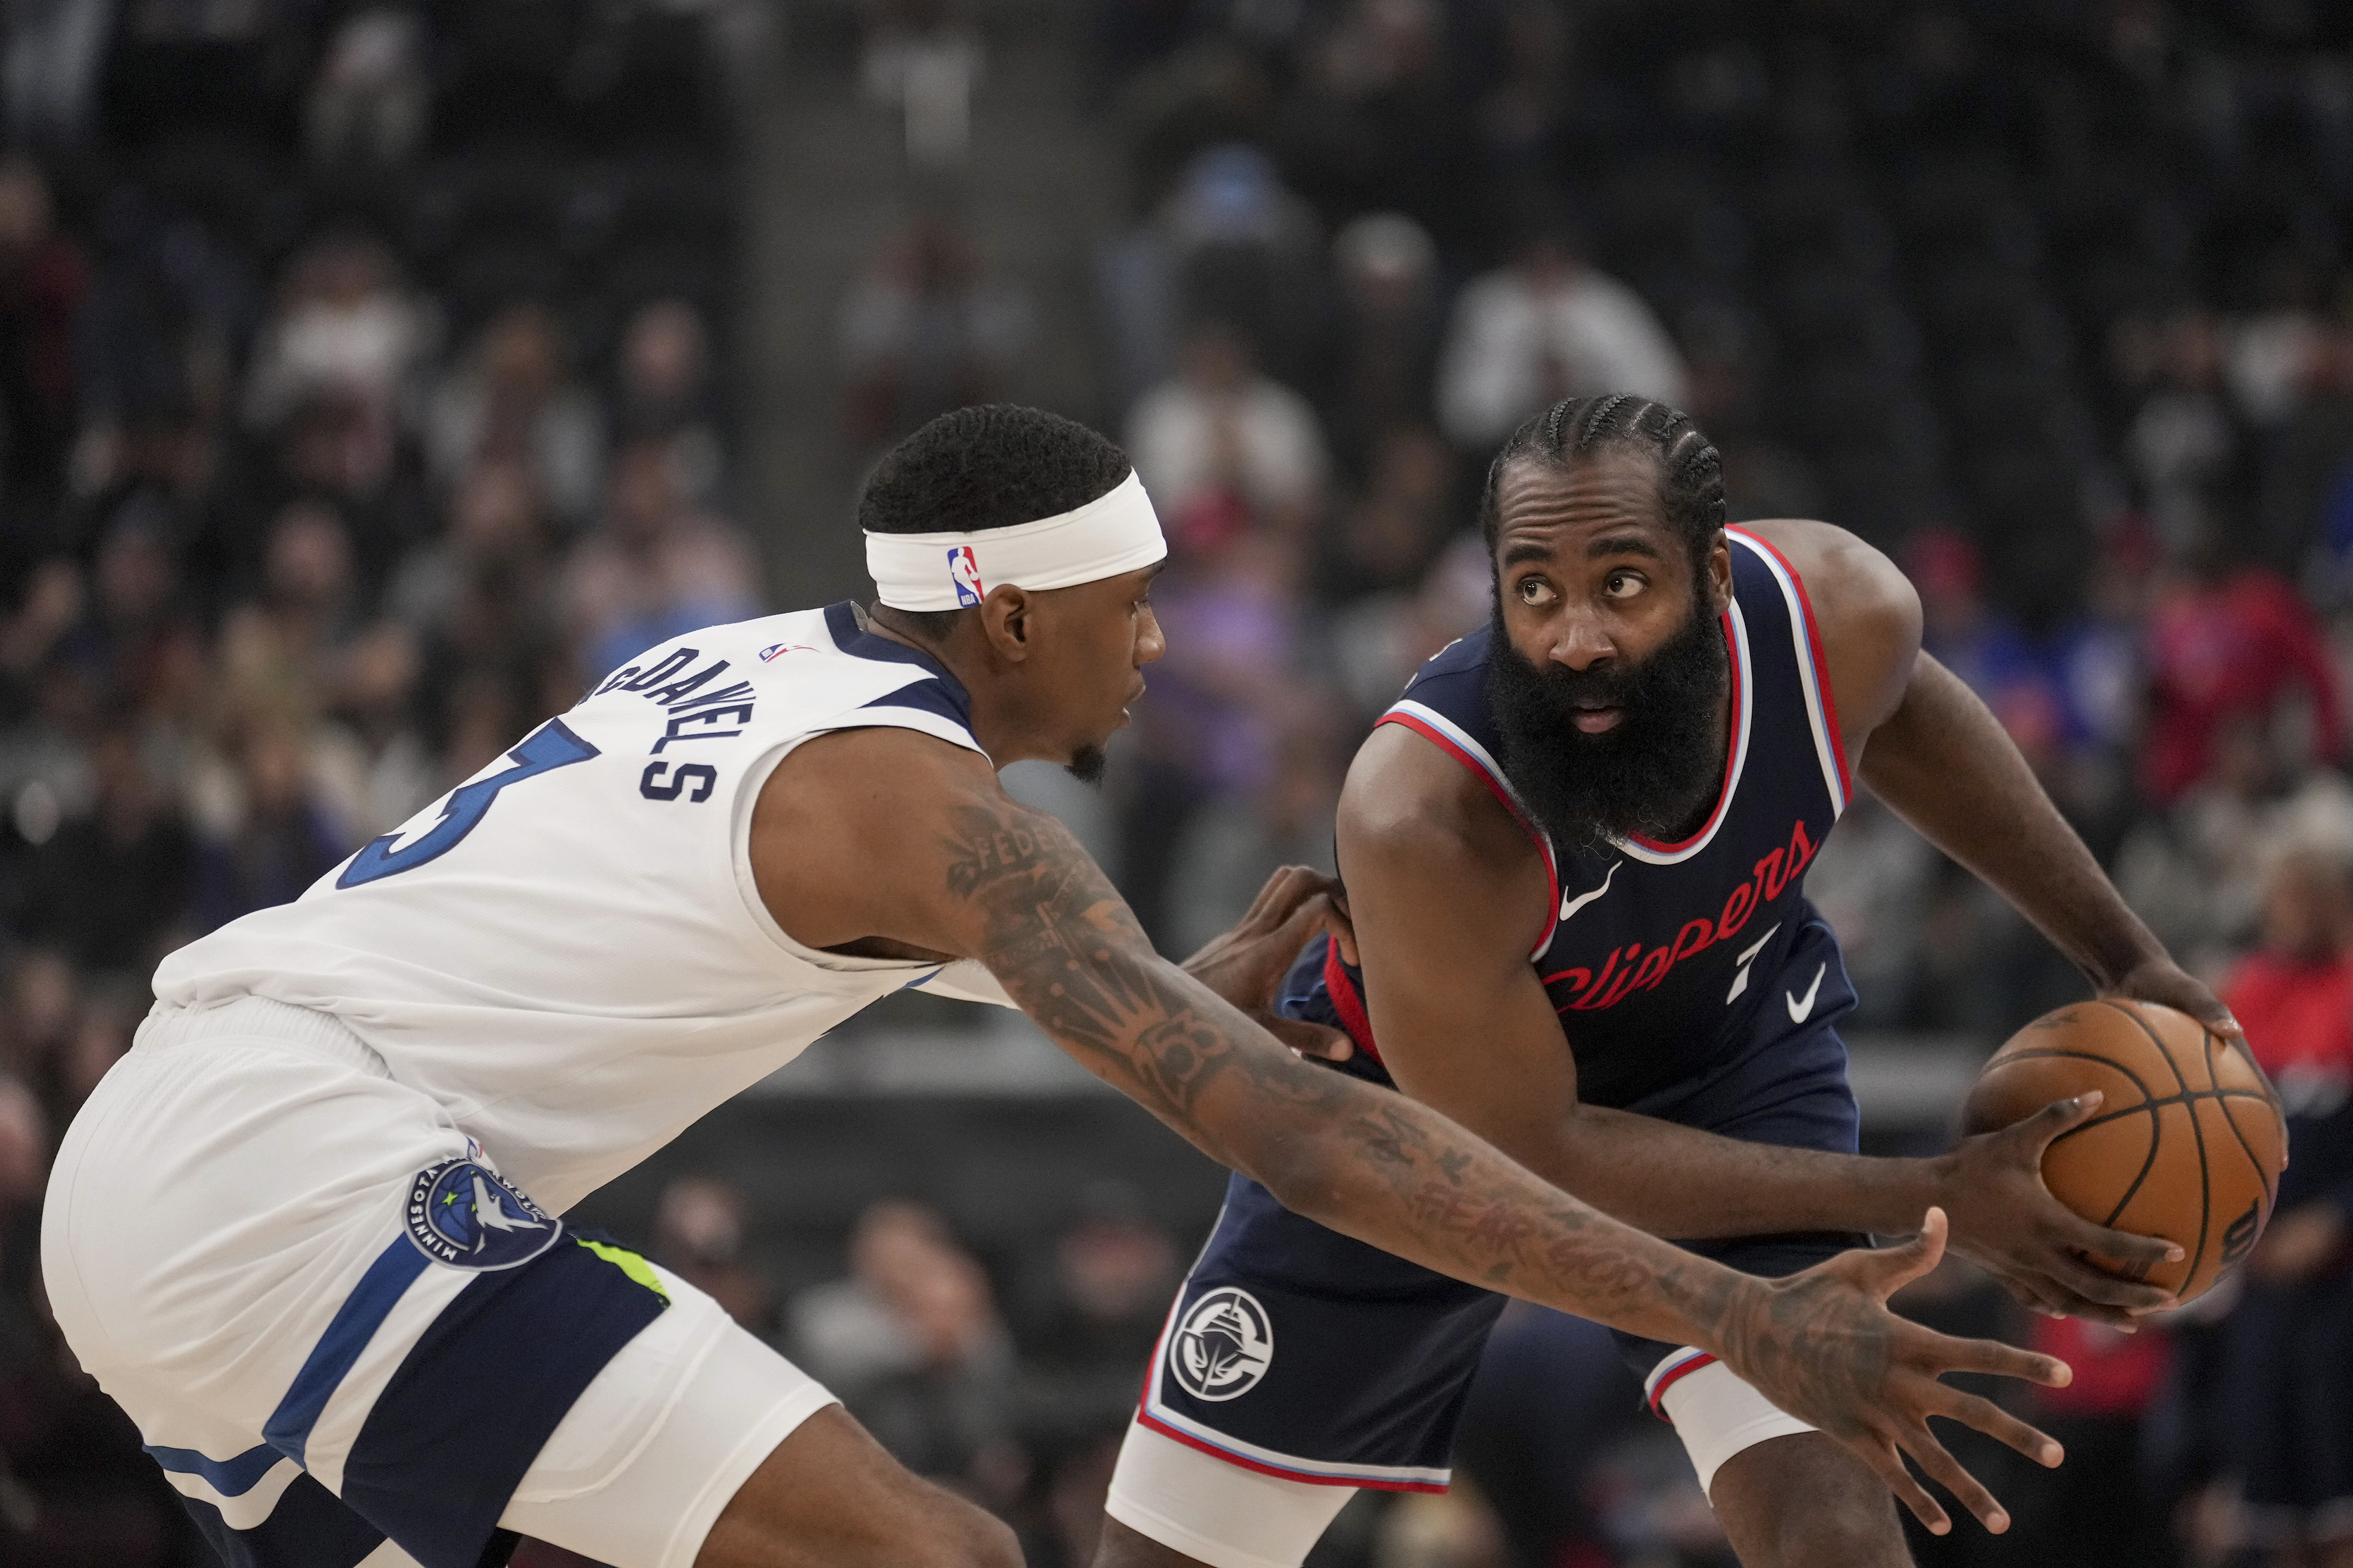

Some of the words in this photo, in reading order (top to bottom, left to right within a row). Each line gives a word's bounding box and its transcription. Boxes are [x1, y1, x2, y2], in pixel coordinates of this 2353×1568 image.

[960, 593, 976, 606] NBA
[575, 646, 757, 804] cDANIELS
[335, 716, 603, 890] 3
[1727, 921, 1782, 1005] 7
[410, 1168, 458, 1261] MINNESOTA
